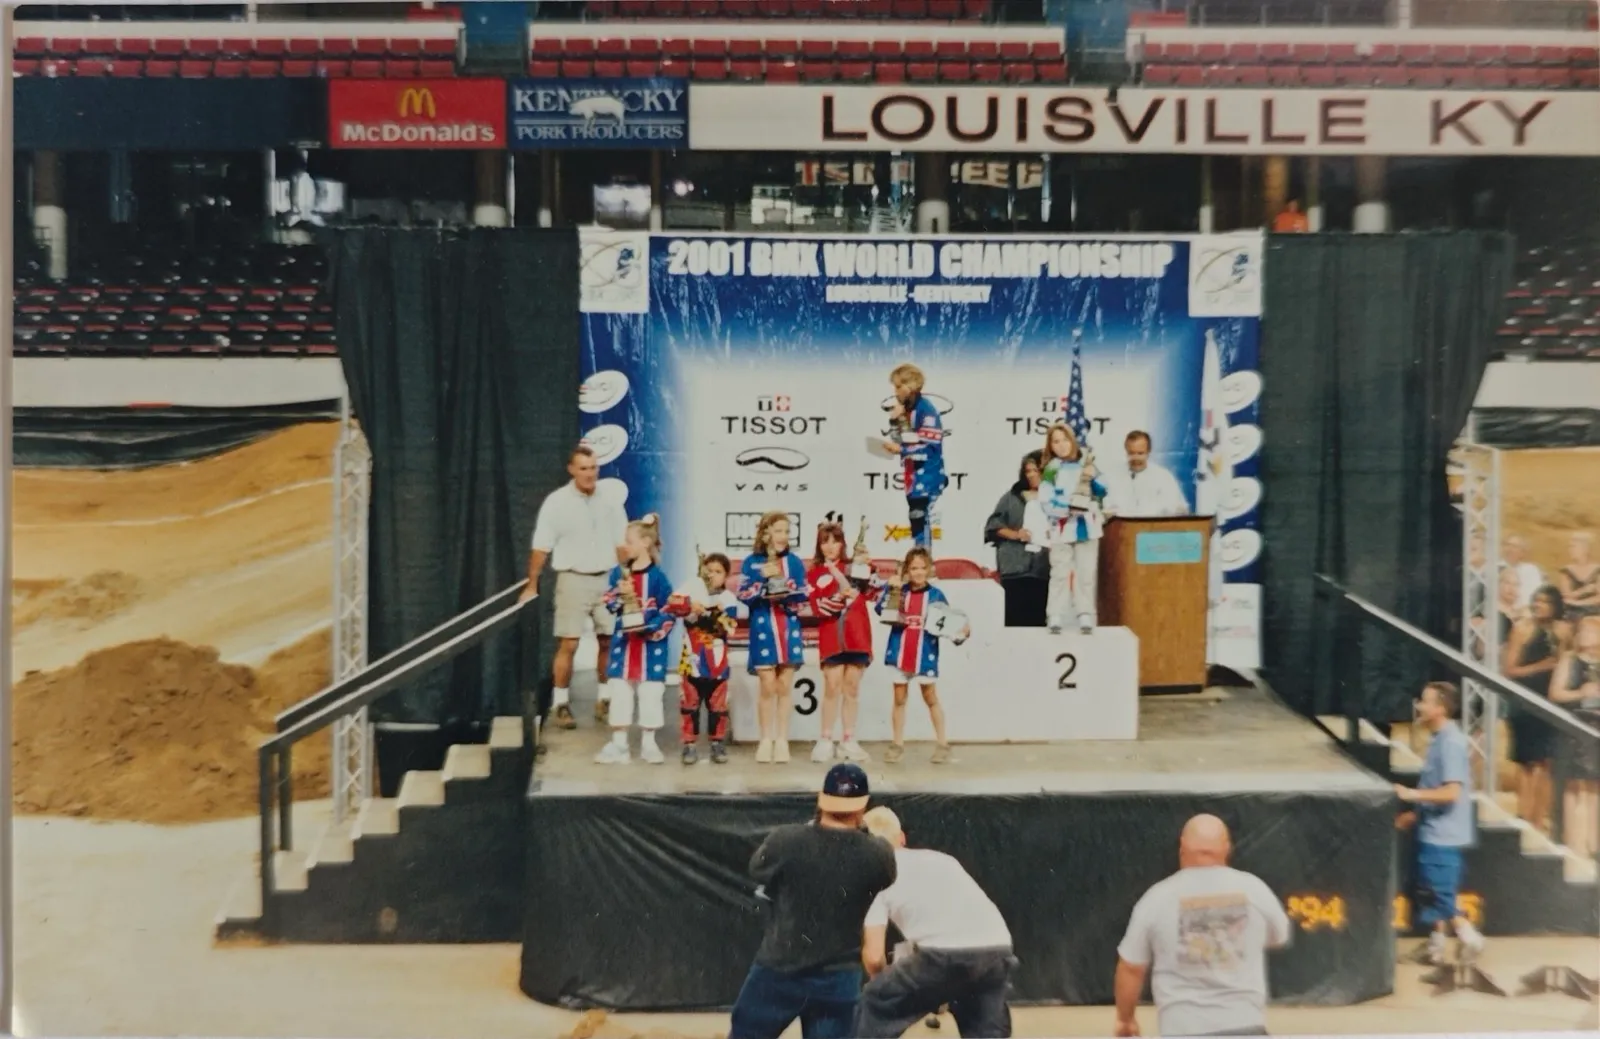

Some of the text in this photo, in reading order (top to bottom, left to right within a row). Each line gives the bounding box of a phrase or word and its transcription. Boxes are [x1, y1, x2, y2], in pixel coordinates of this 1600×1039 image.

[821, 93, 1553, 147] LOUISVILLE KY
[342, 121, 496, 142] McDonald's
[516, 125, 684, 140] PORK PRODUCERS
[667, 239, 1175, 279] 2001 BMX WORLD CHAMPIONSHIP
[720, 415, 828, 435] TISSOT
[1005, 416, 1111, 435] TIST
[735, 483, 809, 492] VANS
[863, 471, 969, 490] TIST
[935, 615, 947, 632] 4
[1055, 652, 1077, 690] 2
[794, 677, 818, 716] 3
